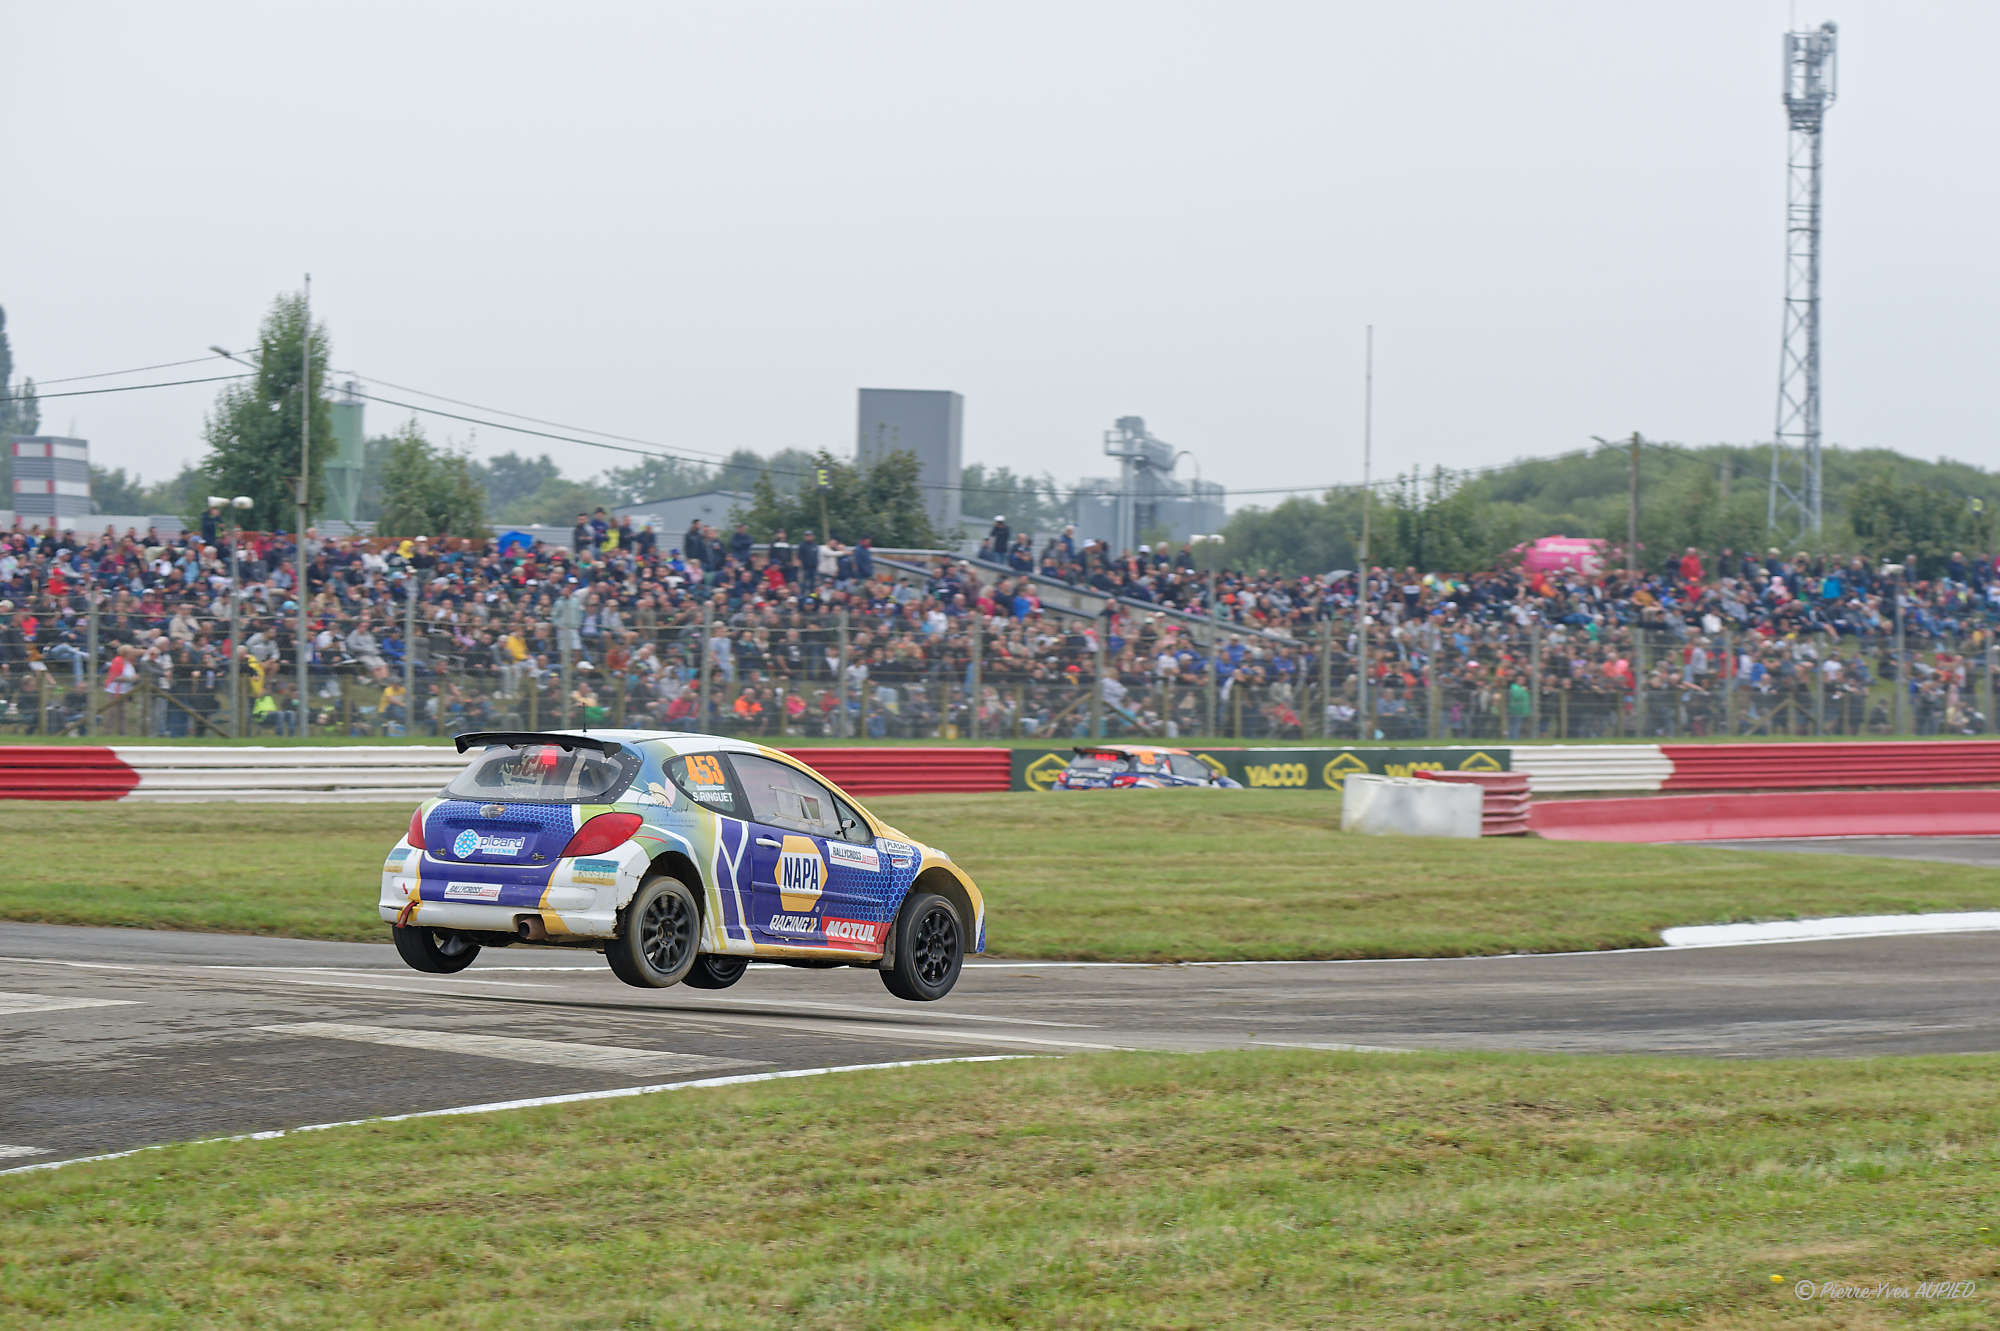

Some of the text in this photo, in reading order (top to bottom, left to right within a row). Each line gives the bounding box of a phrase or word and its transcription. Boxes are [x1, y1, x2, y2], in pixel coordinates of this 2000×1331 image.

[684, 755, 726, 785] 453
[1245, 763, 1308, 787] YACCO
[692, 791, 733, 802] S.RINGUET
[480, 835, 525, 848] picard
[832, 846, 862, 861] RALLYCROSS
[783, 857, 819, 890] NAPA
[769, 914, 809, 932] RACING
[825, 920, 875, 943] MOTUL
